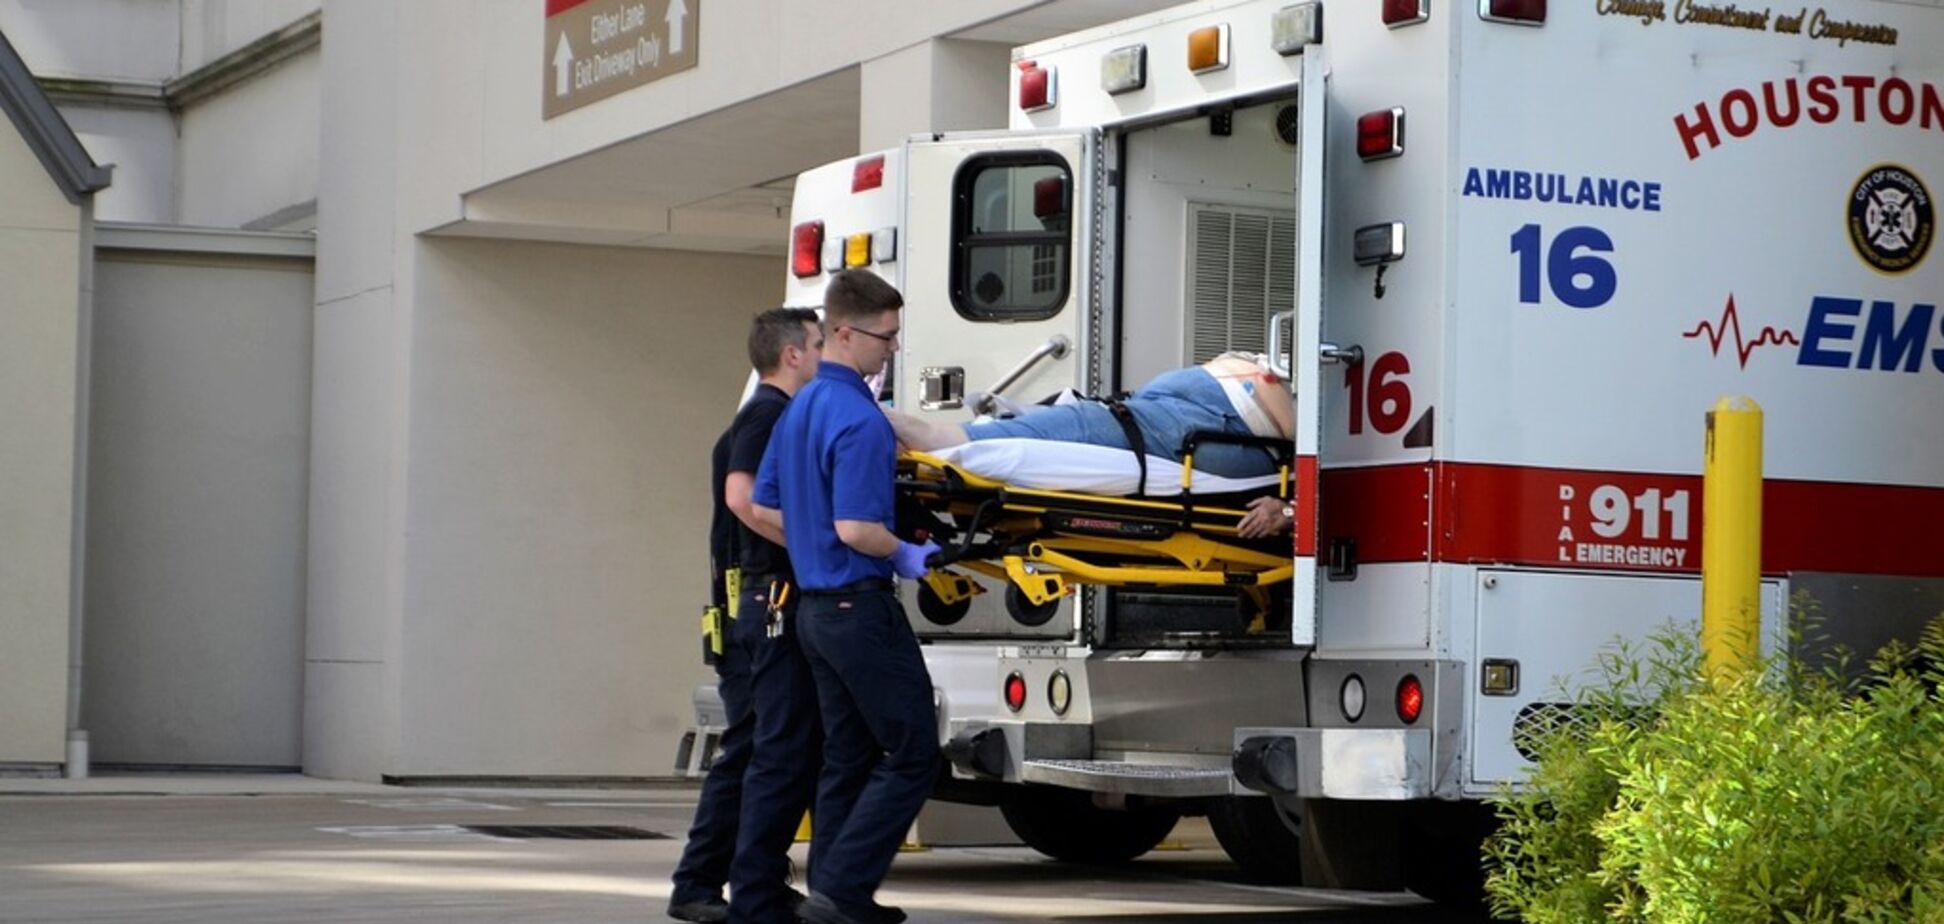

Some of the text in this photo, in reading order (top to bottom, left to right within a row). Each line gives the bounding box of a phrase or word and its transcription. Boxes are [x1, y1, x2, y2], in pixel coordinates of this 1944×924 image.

[591, 4, 644, 44] Either Lane
[1774, 8, 1807, 34] and
[1809, 8, 1898, 47] Compassion
[575, 32, 660, 89] Exit Driveway Only
[1673, 75, 1944, 161] HOUSTON
[1462, 167, 1661, 212] AMBULANCE
[1856, 177, 1874, 201] CITY
[1872, 171, 1886, 183] OF
[1510, 224, 1618, 308] 16
[1796, 295, 1944, 375] EM
[1344, 351, 1412, 435] 16
[1558, 484, 1575, 562] DIAL
[1589, 484, 1690, 541] 911
[1576, 543, 1687, 567] EMERGENCY
